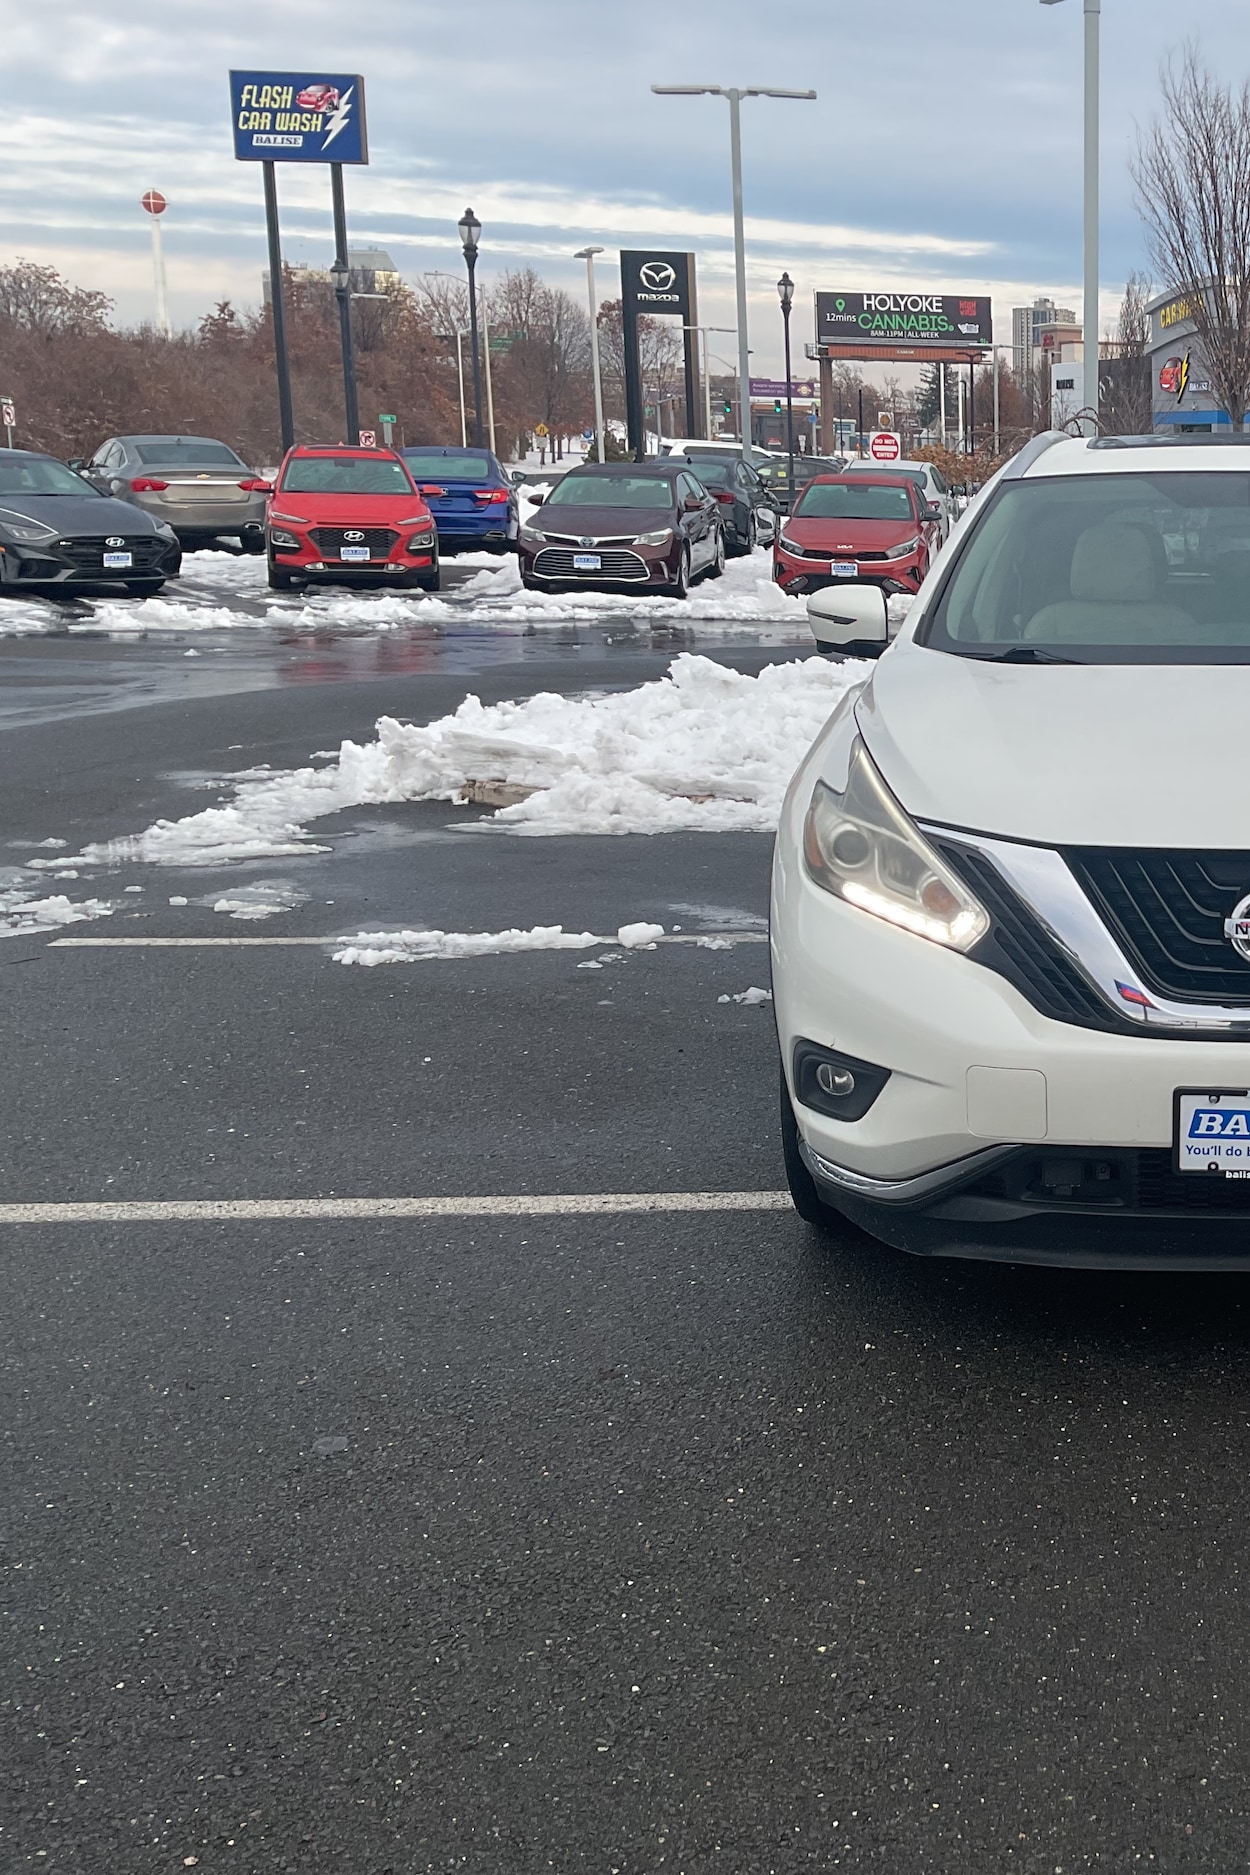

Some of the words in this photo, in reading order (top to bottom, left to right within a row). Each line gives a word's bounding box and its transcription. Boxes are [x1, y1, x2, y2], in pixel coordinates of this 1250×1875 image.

[241, 85, 293, 108] FLASH
[238, 111, 271, 130] CAR
[275, 113, 323, 132] WASH
[255, 135, 301, 145] BALISE
[863, 294, 943, 313] HOLYOKE
[825, 312, 857, 323] 12mins
[1160, 303, 1177, 329] CAR
[1185, 1144, 1222, 1157] You'll
[1226, 1145, 1242, 1157] do
